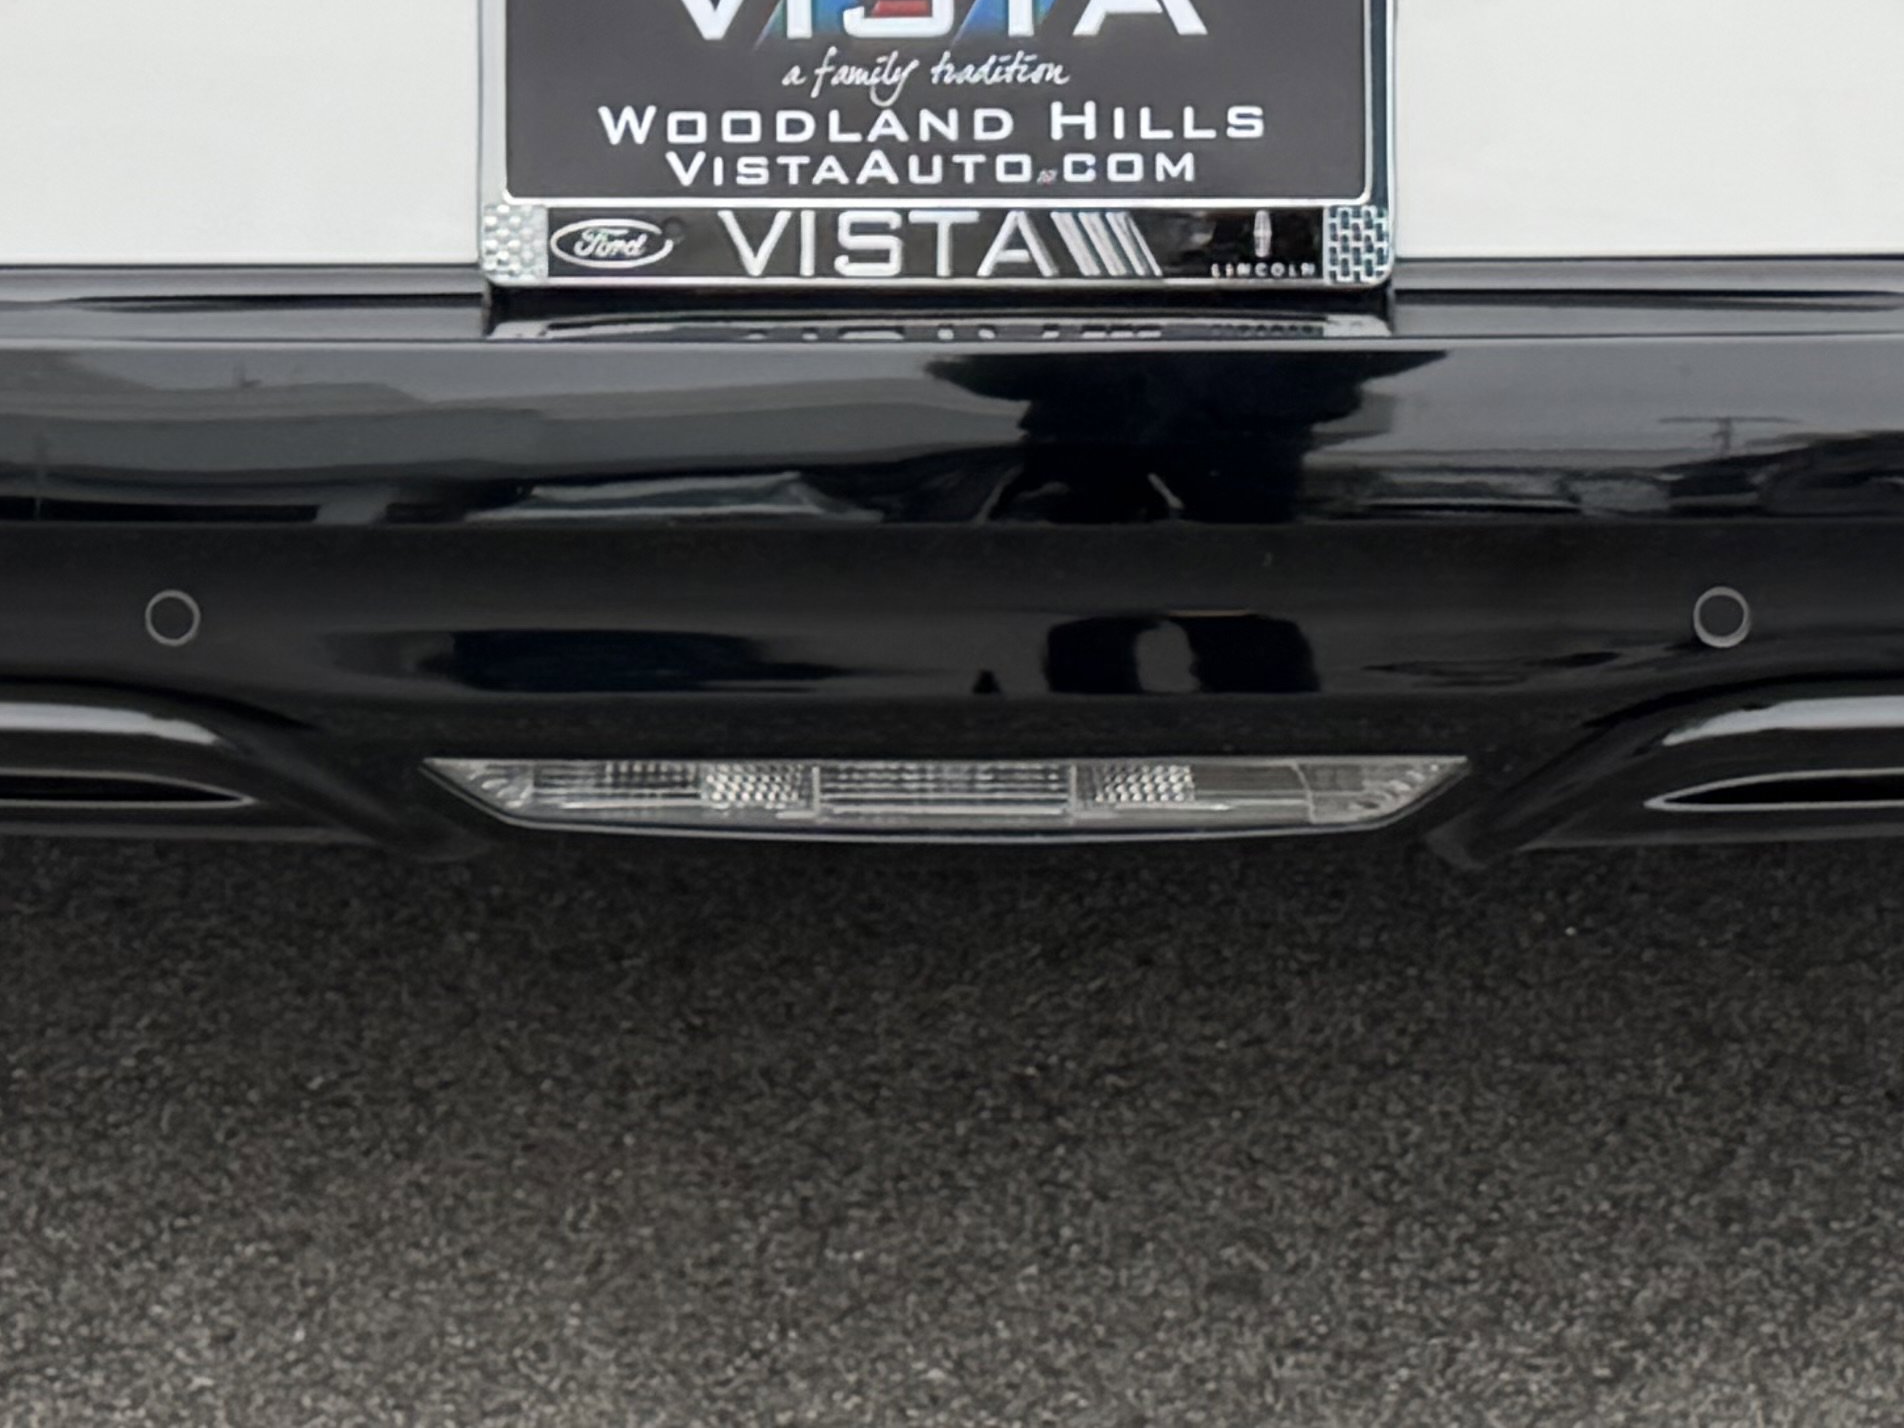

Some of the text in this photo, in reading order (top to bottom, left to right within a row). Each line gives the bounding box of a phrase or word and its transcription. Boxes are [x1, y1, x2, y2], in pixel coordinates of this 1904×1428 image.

[781, 45, 1070, 108] a family tradition
[597, 100, 1265, 145] WOODLAND HILLS
[716, 209, 1060, 278] VISTA
[1210, 262, 1316, 279] LINCOLN
